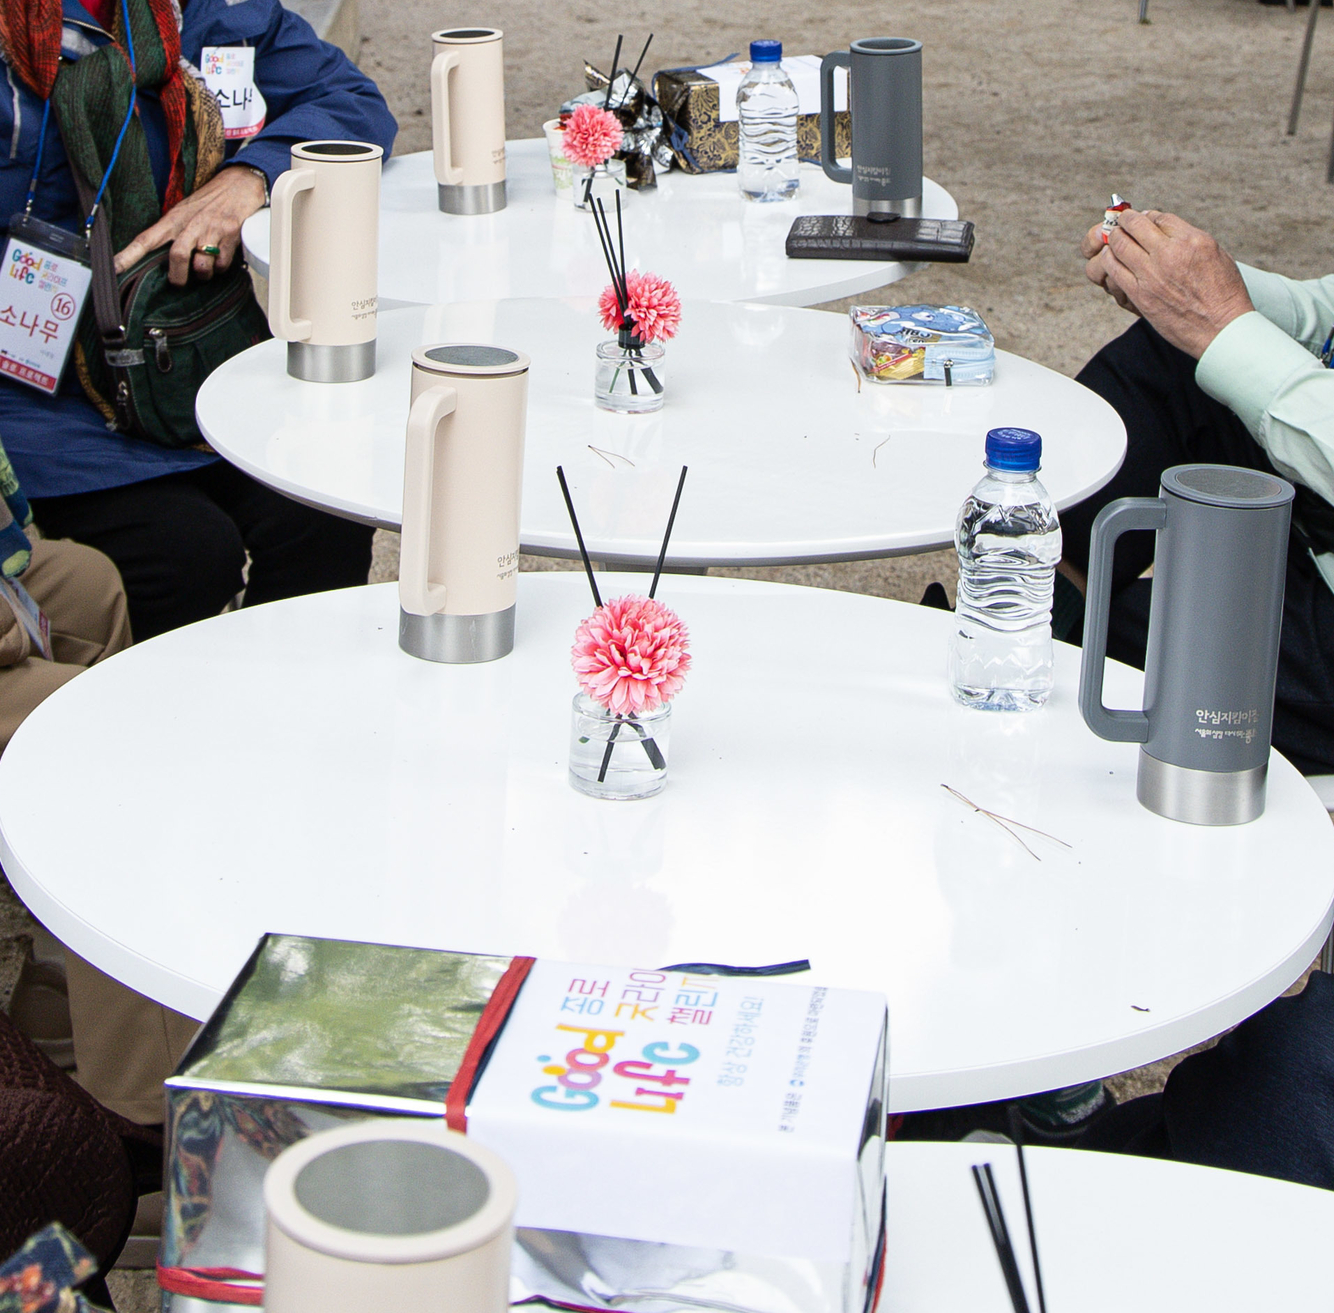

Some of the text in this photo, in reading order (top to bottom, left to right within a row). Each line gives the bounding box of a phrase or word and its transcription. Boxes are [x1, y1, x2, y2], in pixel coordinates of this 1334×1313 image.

[12, 249, 43, 271] Good
[560, 978, 610, 1015] 종로
[530, 1023, 625, 1112] Good
[717, 996, 765, 1087] 항상 건강하세요!
